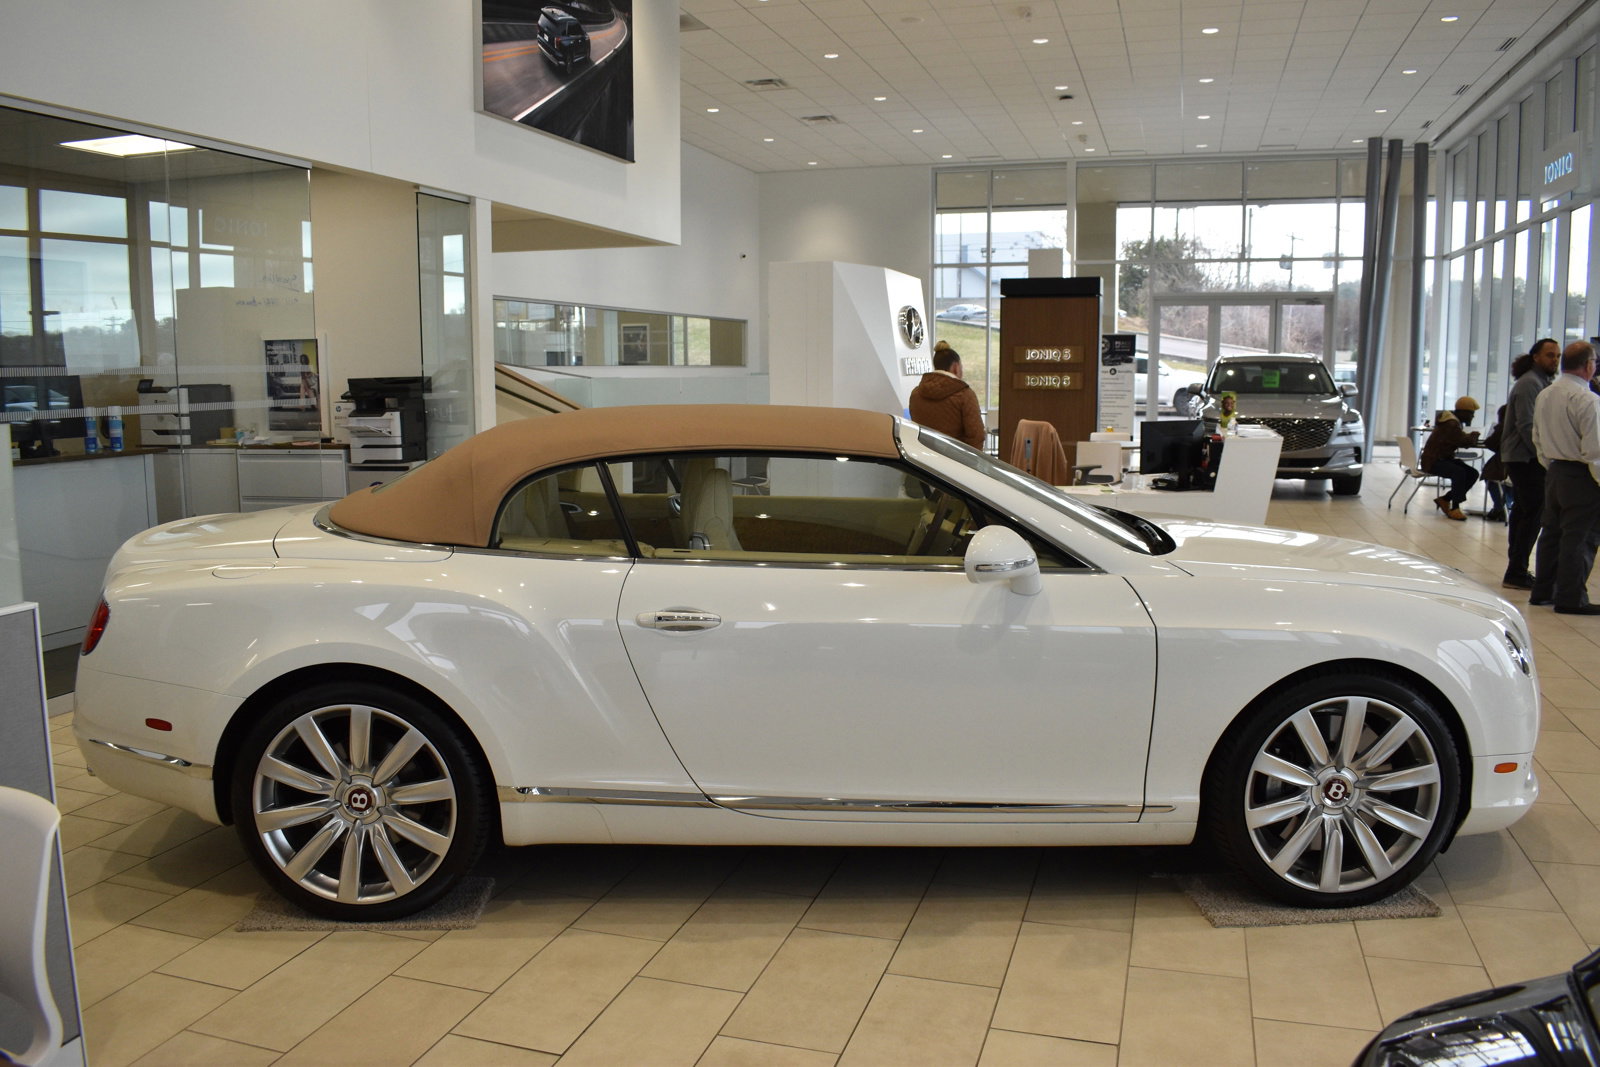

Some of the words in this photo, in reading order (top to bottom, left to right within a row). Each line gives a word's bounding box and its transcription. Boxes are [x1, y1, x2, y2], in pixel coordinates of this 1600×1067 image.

[1544, 152, 1573, 185] IONIQ
[1026, 348, 1061, 362] IONIQ
[1063, 348, 1071, 361] 5
[1025, 375, 1061, 389] IONIQ
[1328, 783, 1345, 800] B
[351, 793, 368, 809] B
